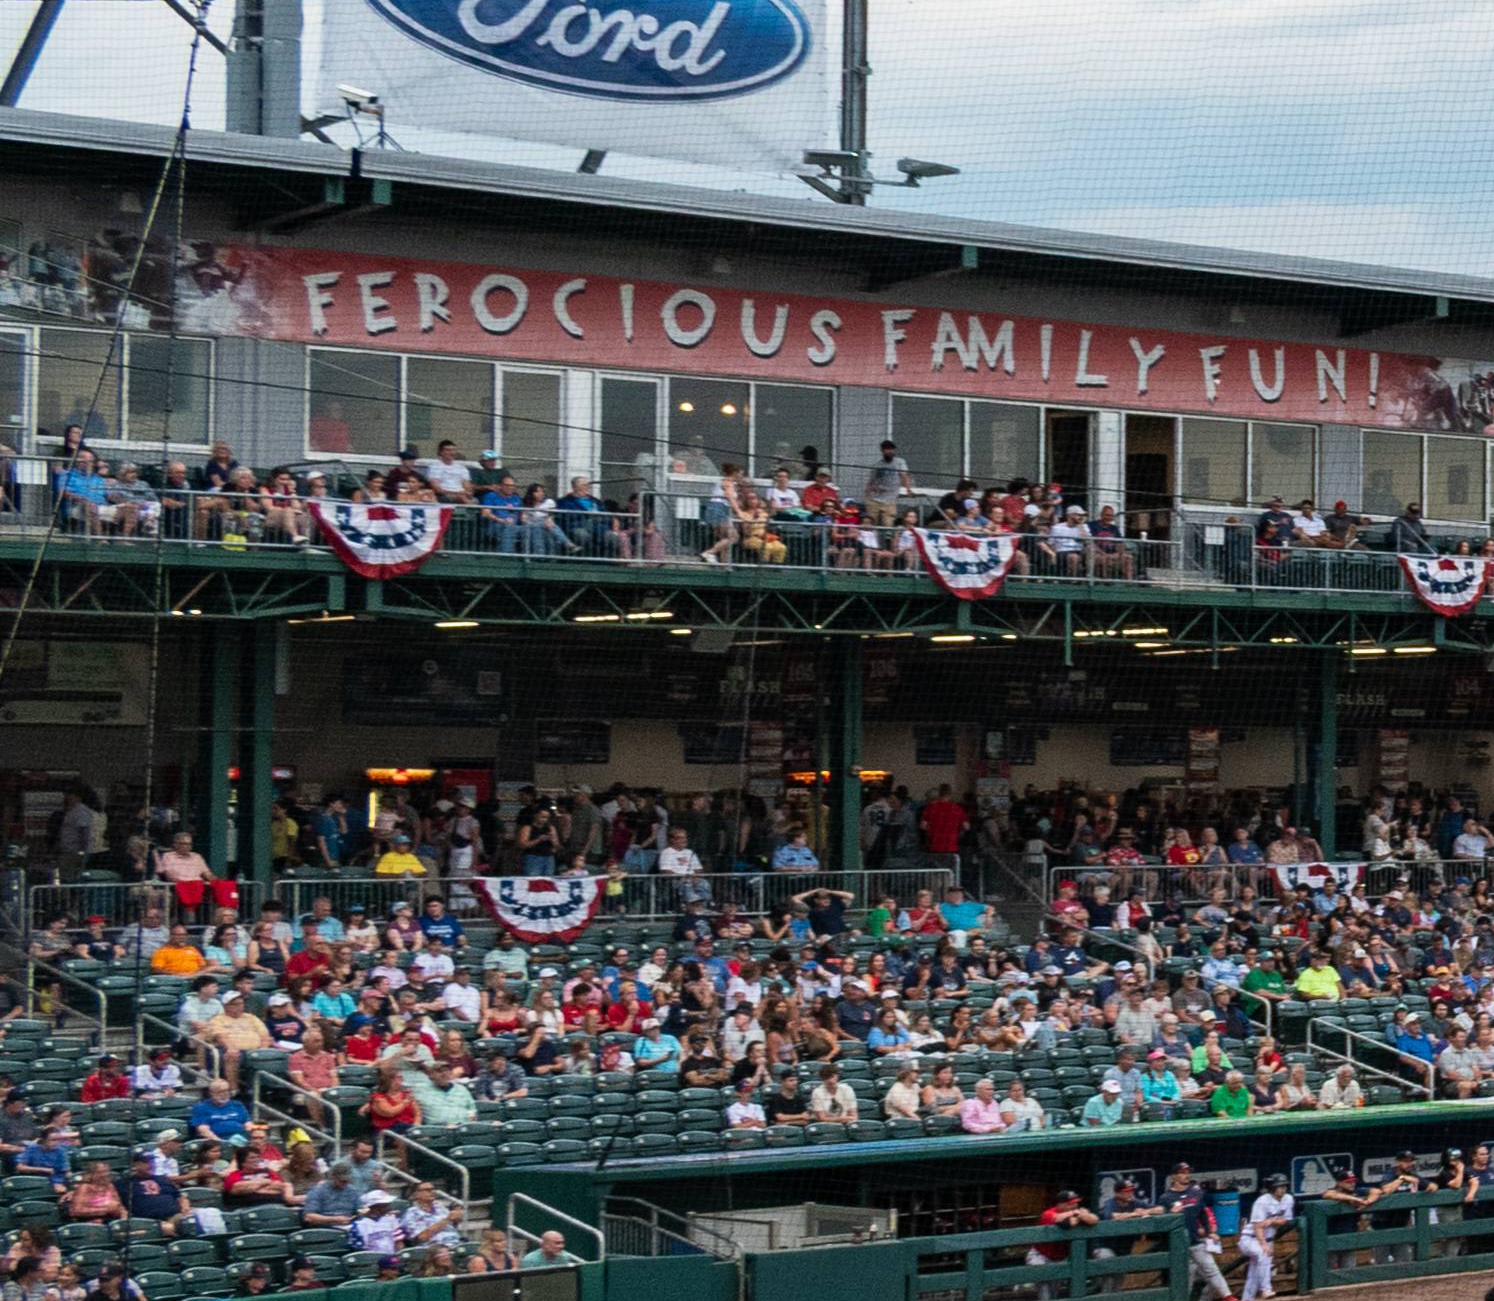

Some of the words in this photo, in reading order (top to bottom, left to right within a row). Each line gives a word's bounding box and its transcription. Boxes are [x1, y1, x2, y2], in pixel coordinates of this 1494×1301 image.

[302, 271, 843, 367] FEROCIOUS
[881, 308, 1167, 395] FAMILY
[1200, 344, 1383, 409] FUN!
